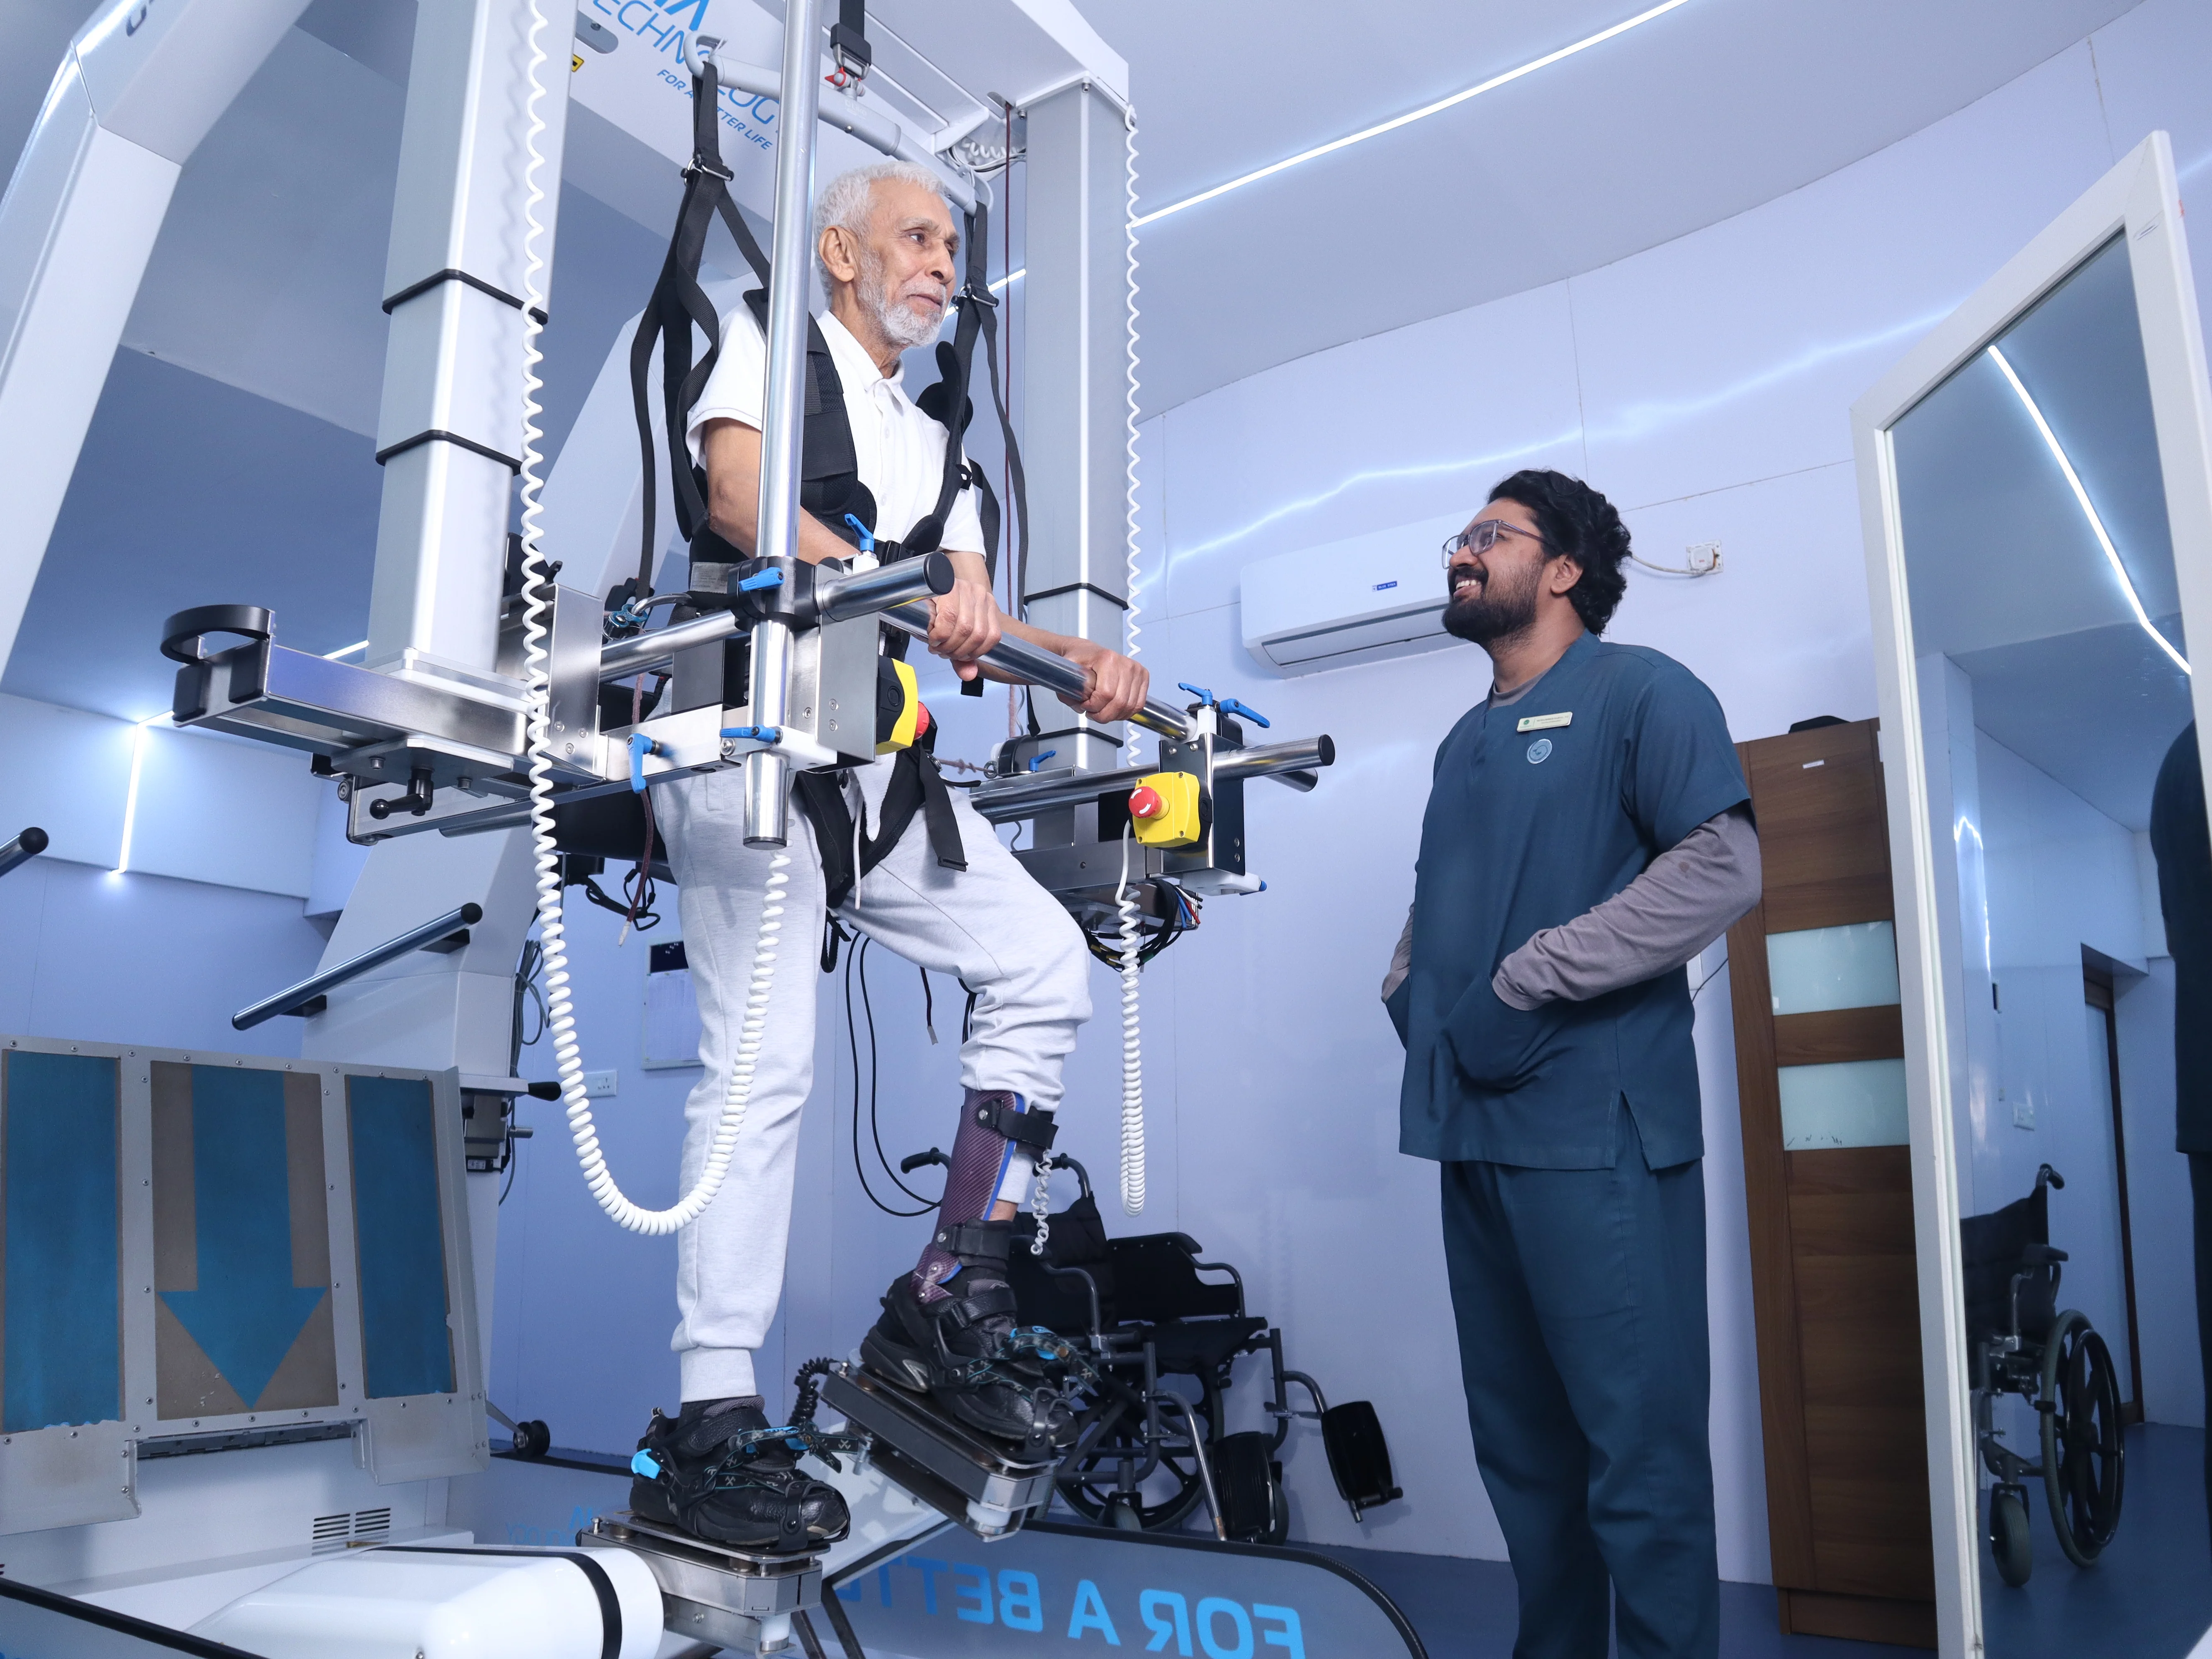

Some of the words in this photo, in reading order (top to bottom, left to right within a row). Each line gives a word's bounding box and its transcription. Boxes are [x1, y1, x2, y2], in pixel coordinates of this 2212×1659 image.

[656, 69, 686, 91] FOR
[717, 106, 746, 131] TTER
[744, 129, 773, 150] LIFE
